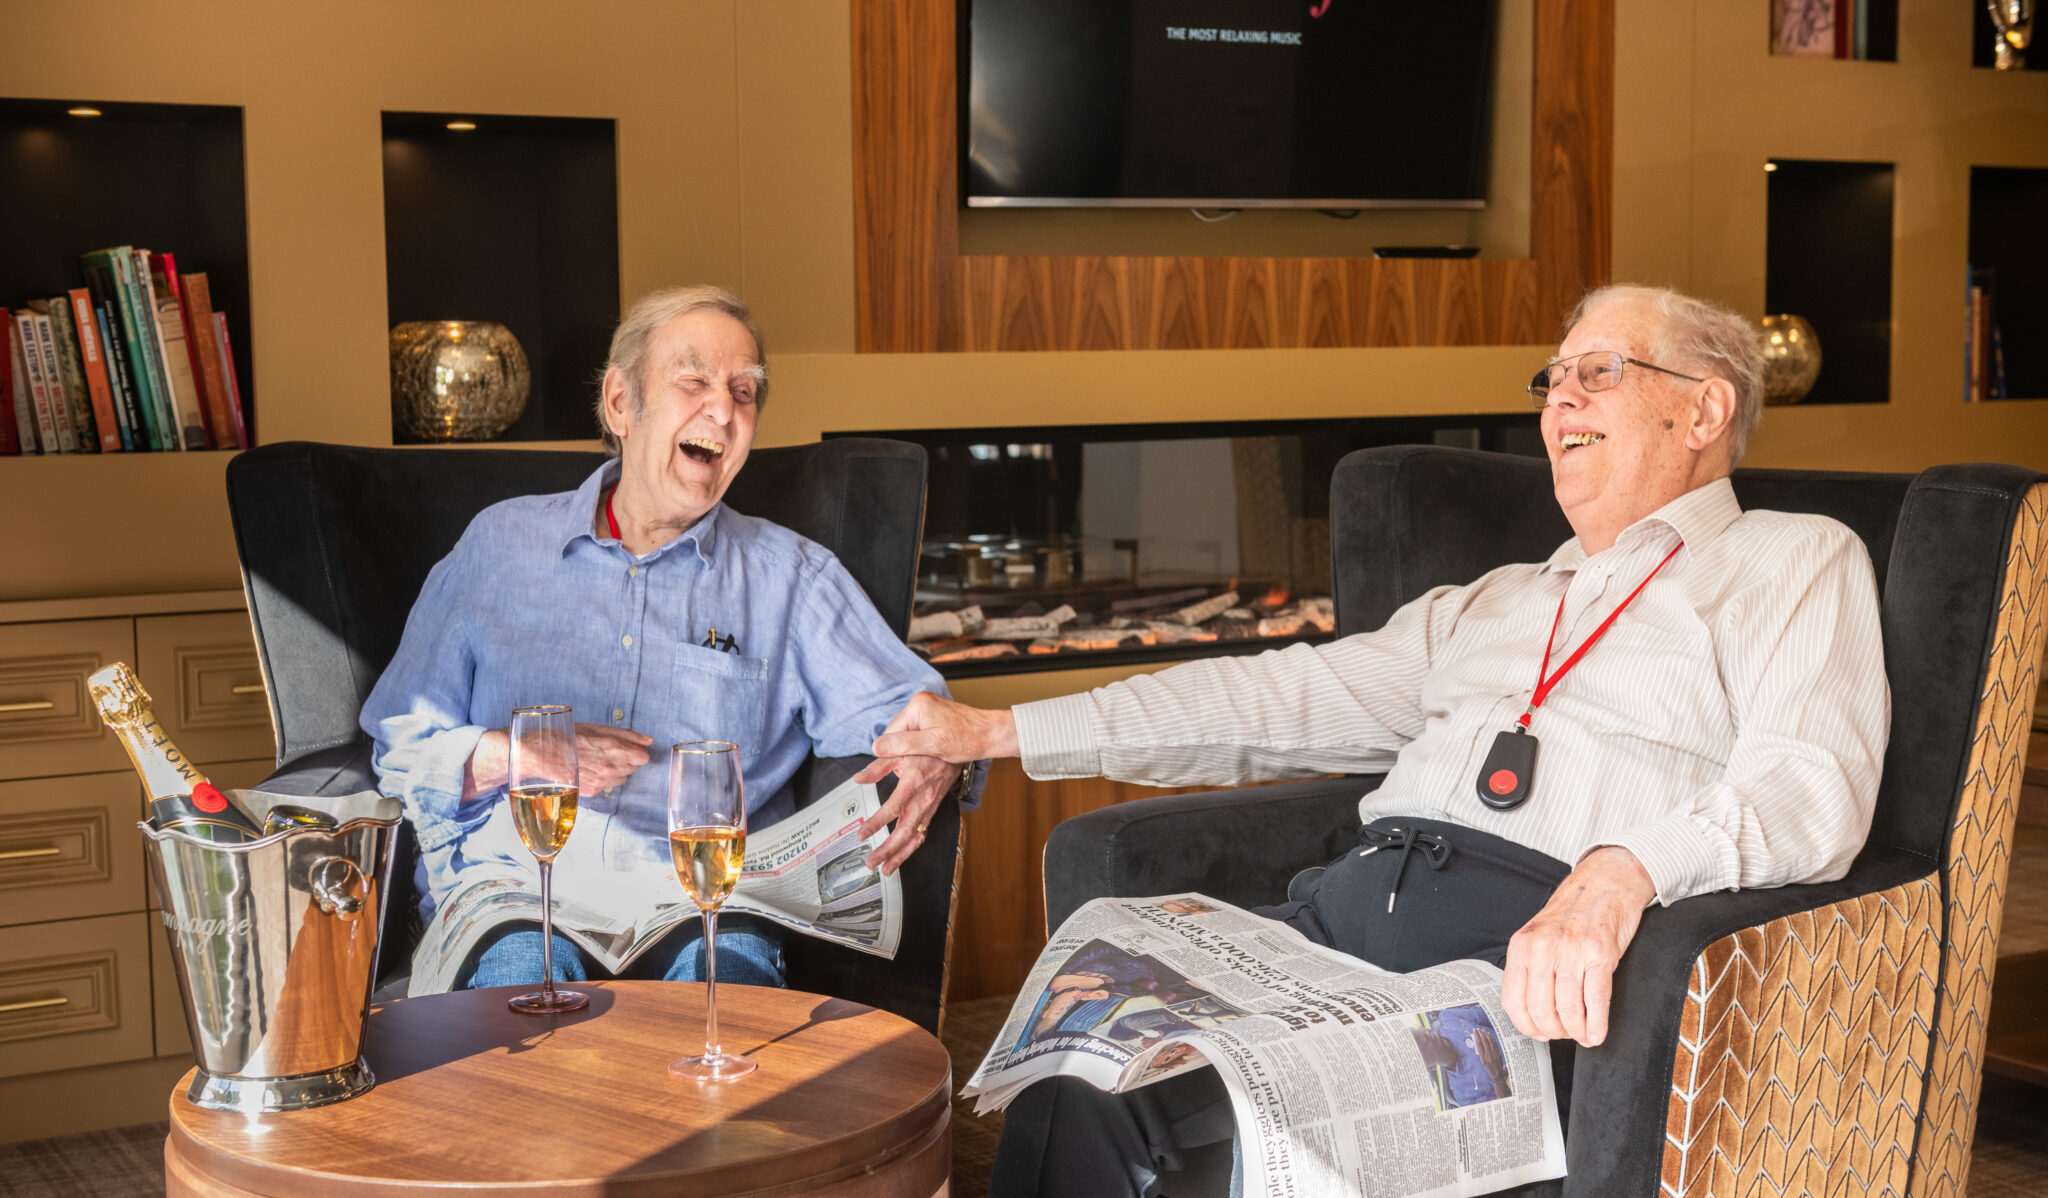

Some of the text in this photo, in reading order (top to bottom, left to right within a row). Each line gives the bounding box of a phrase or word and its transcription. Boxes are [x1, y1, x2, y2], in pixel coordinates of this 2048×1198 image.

[1166, 27, 1302, 45] THE MOST RELAXING MUSIC
[21, 320, 34, 342] MARK
[38, 320, 51, 342] MARK
[776, 841, 808, 865] 01202
[1140, 905, 1212, 935] MONTH
[1179, 931, 1222, 955] offers
[1303, 1011, 1326, 1024] to
[1085, 1039, 1132, 1063] shocking
[1241, 1048, 1254, 1059] to
[1261, 1082, 1279, 1106] put
[1271, 1109, 1284, 1133] are
[1278, 1138, 1290, 1169] they
